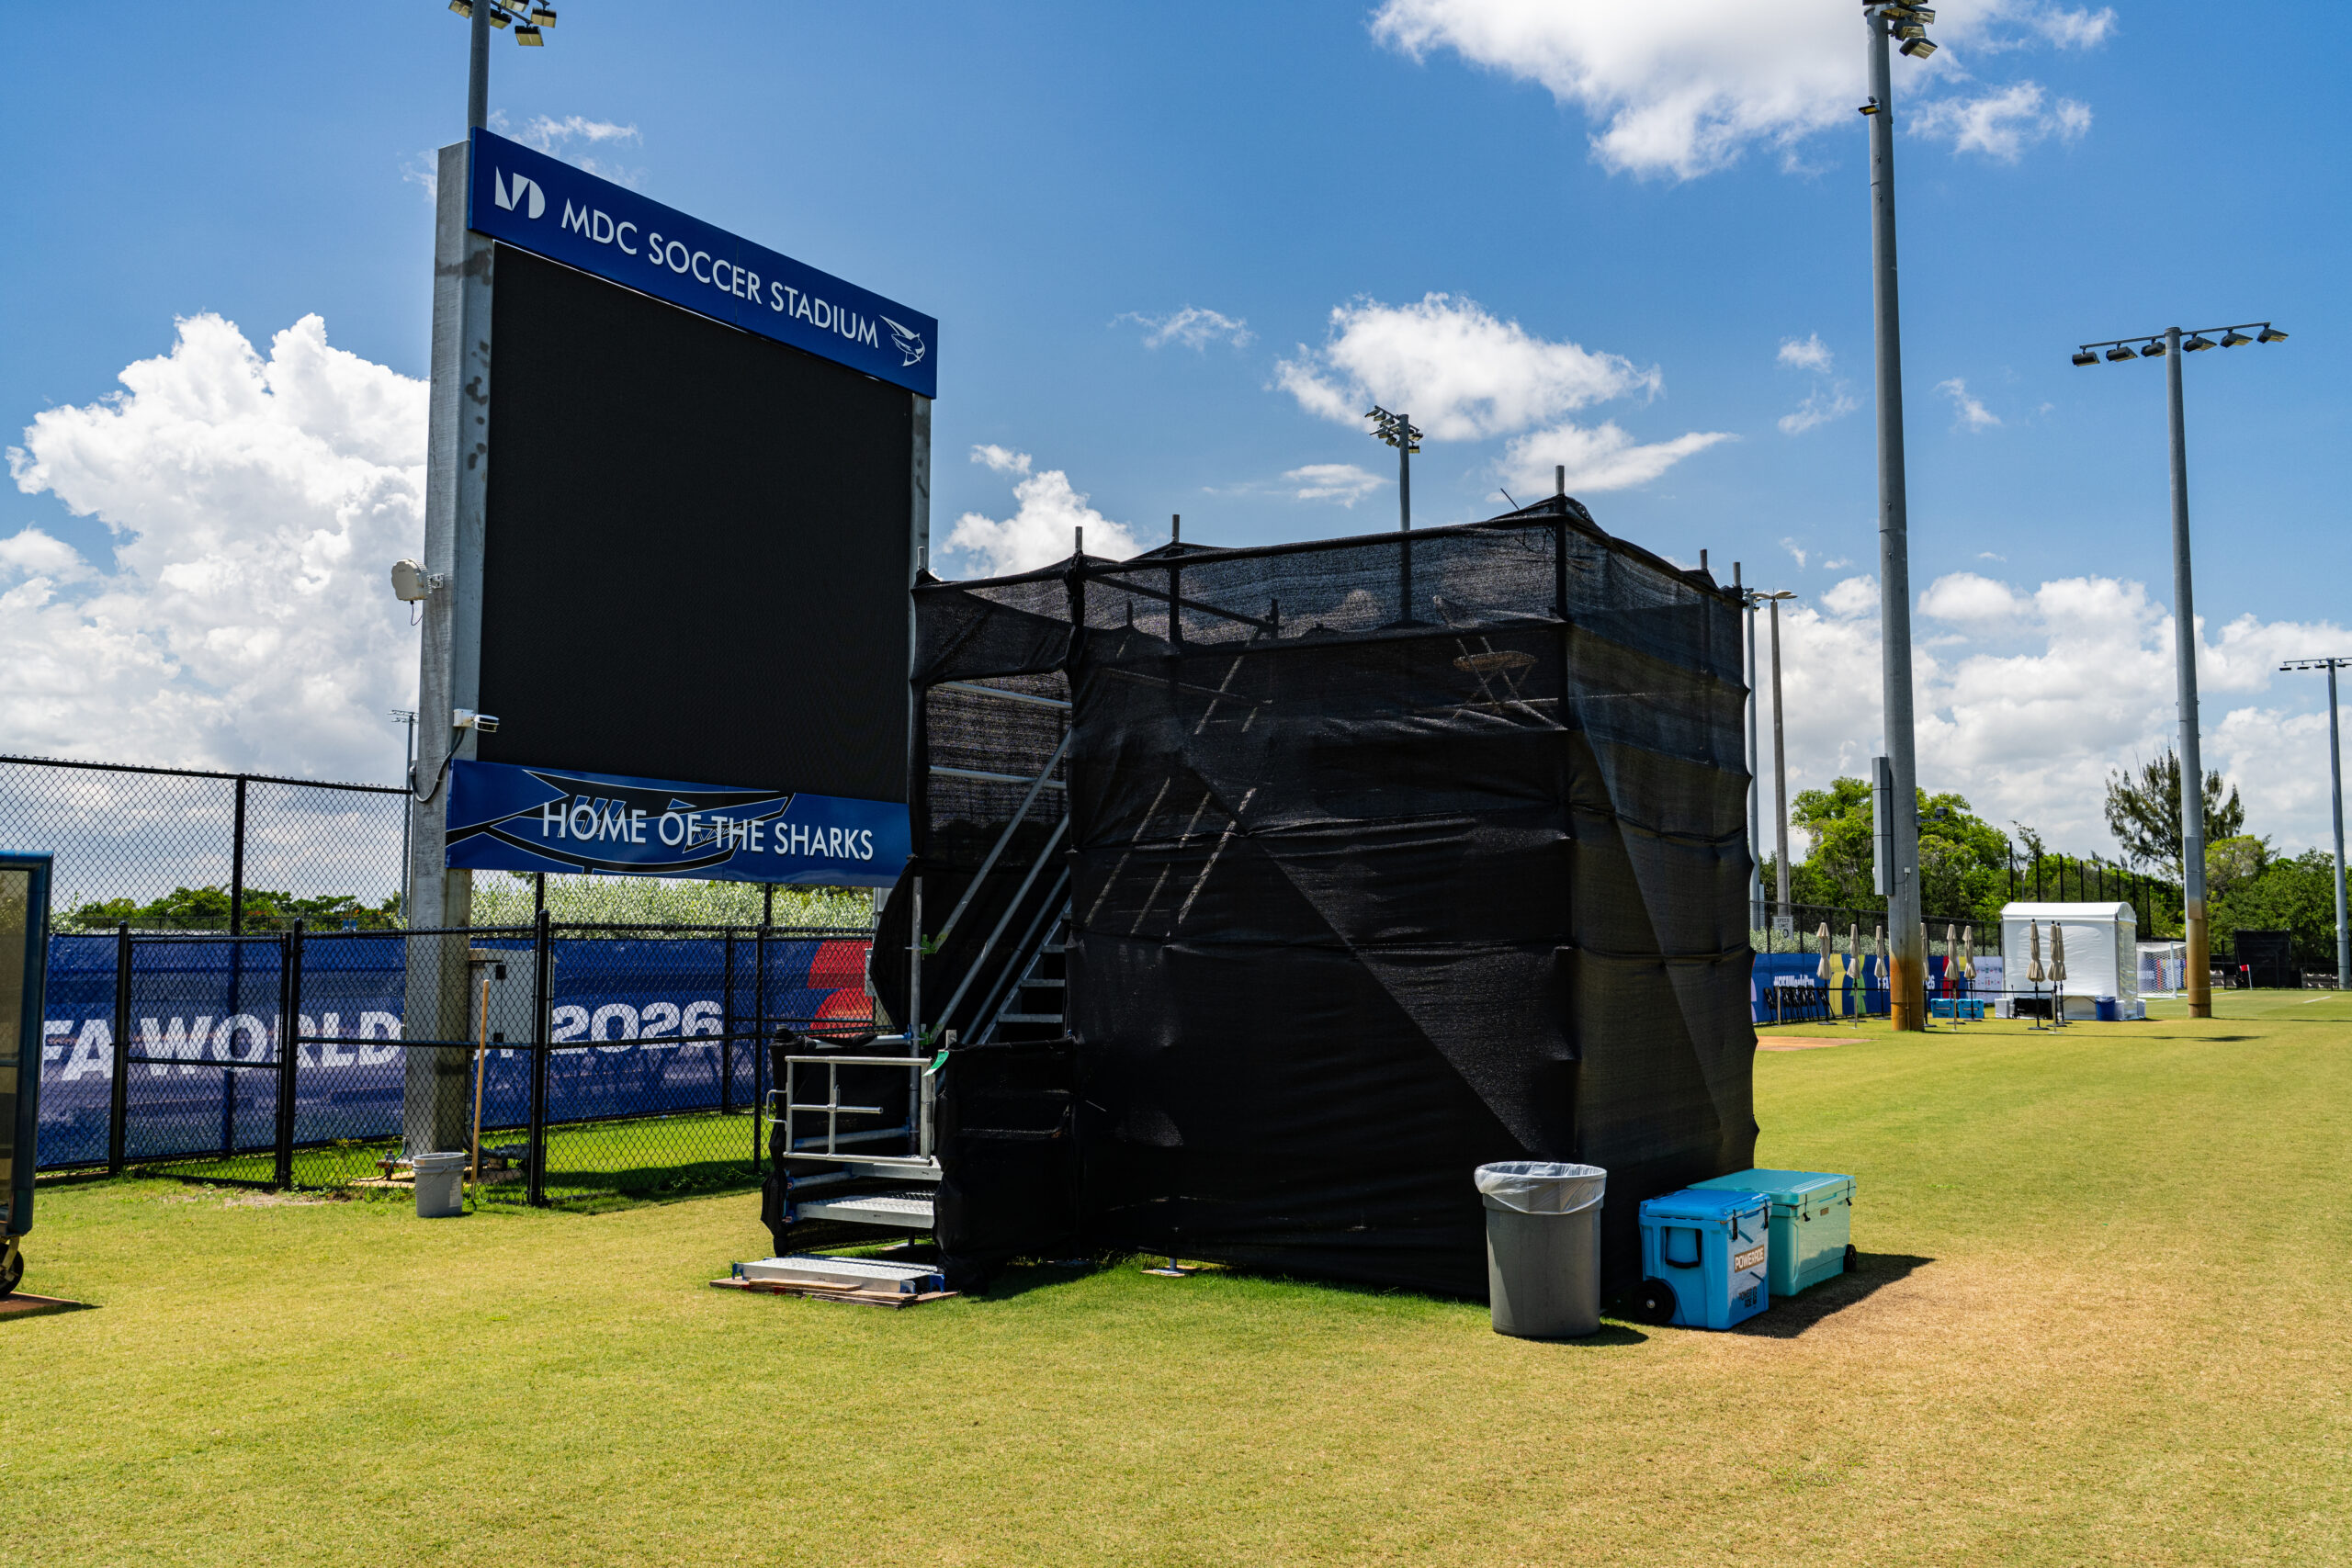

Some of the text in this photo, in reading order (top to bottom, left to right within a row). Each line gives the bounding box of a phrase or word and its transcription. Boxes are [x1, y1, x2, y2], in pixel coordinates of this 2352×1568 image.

[560, 197, 879, 349] MDC SOCCER STADIUM
[543, 802, 873, 861] HOME OF THE SHARKS
[41, 1019, 114, 1081] FA
[549, 1001, 724, 1055] 2026
